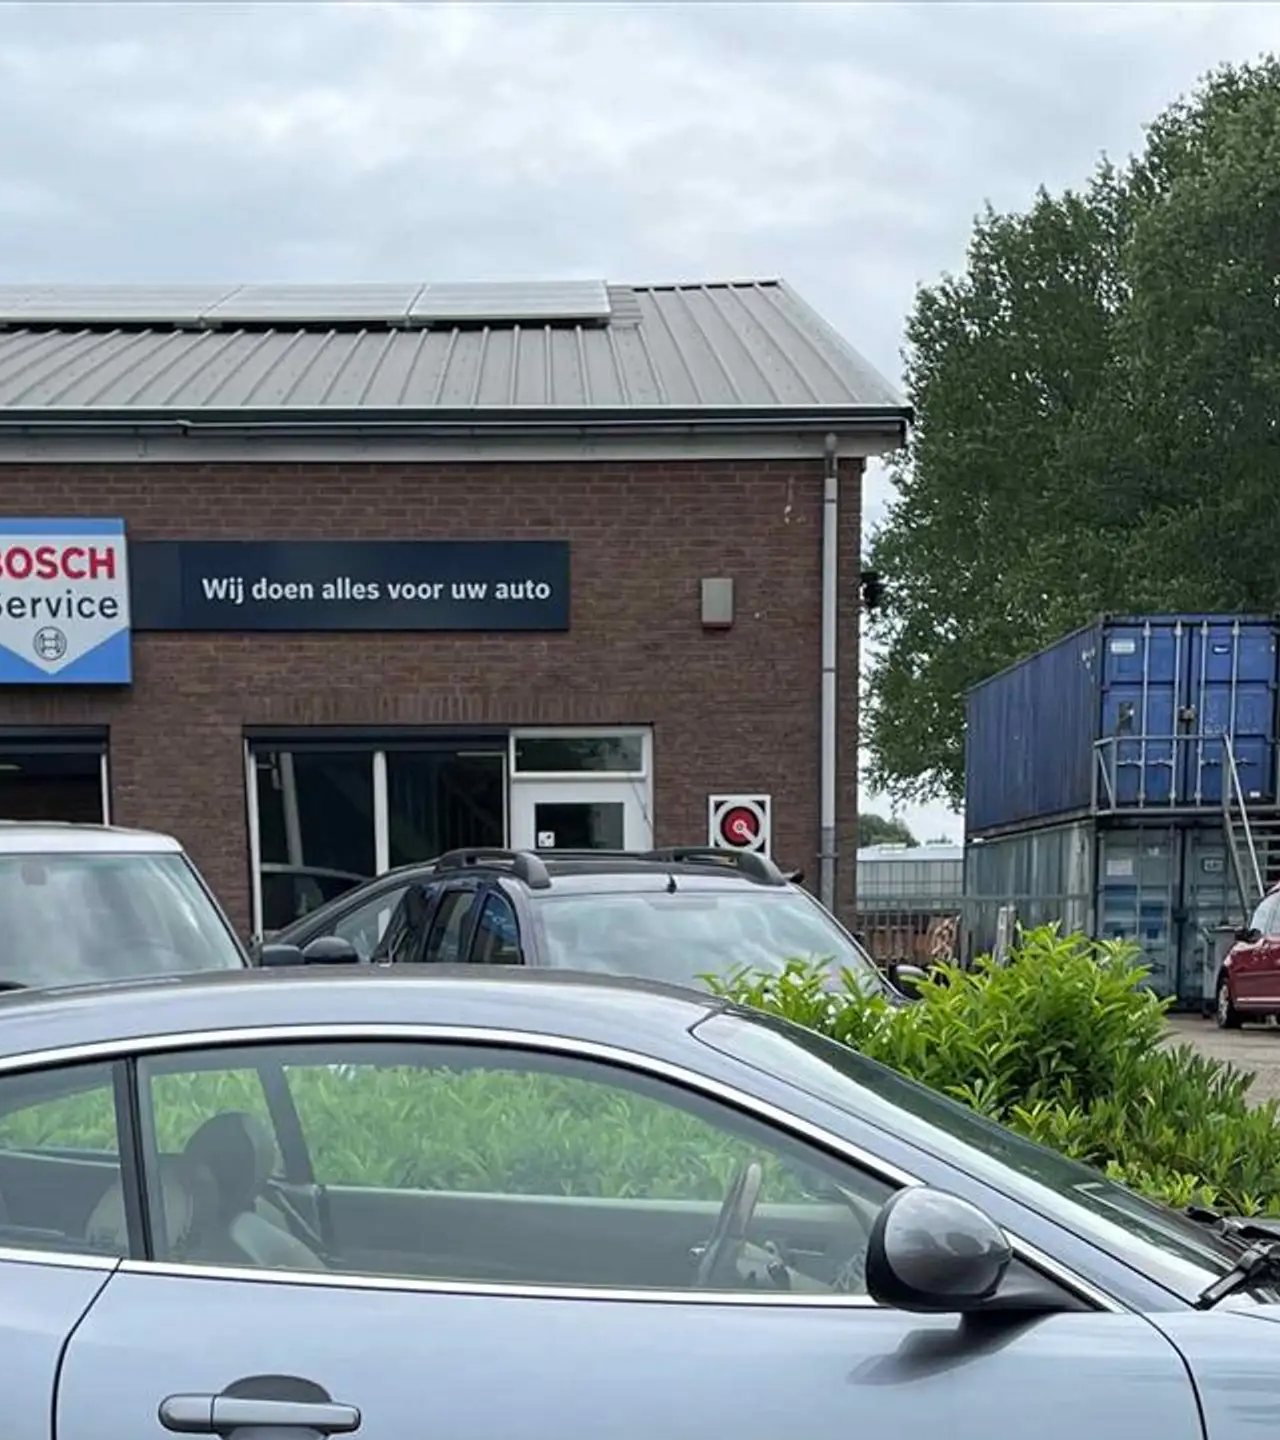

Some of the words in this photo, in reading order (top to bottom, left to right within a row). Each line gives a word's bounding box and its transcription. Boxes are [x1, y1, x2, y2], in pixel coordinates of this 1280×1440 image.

[202, 577, 244, 604] Wij
[252, 577, 314, 600] doen
[322, 577, 380, 600] alles
[387, 582, 443, 600] voor
[451, 582, 487, 600] uw
[495, 579, 552, 600] auto
